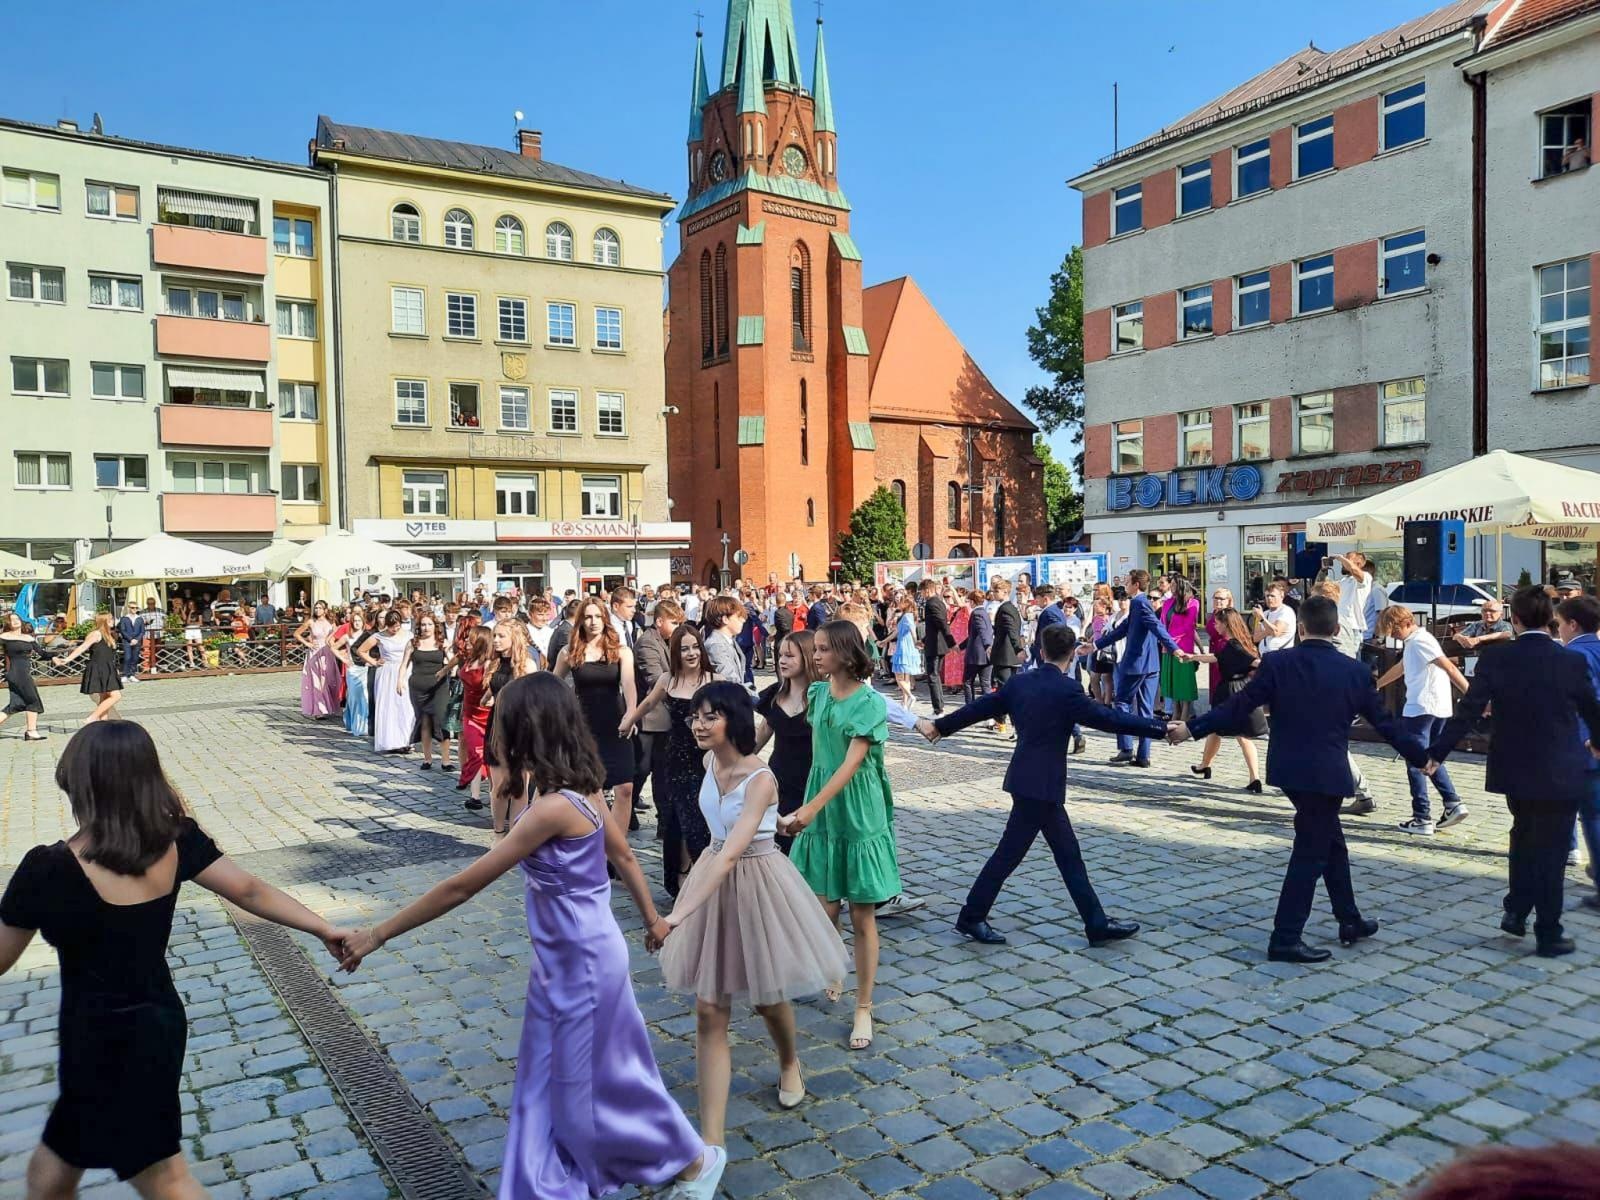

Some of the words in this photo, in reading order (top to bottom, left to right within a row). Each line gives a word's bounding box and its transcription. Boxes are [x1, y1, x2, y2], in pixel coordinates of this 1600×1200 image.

[1106, 464, 1261, 511] BOLKO
[1276, 459, 1421, 496] zaprasza
[424, 522, 446, 531] TEB
[552, 522, 641, 536] ROSSMANN
[5, 568, 37, 577] Kozel
[102, 568, 134, 577] Kozel
